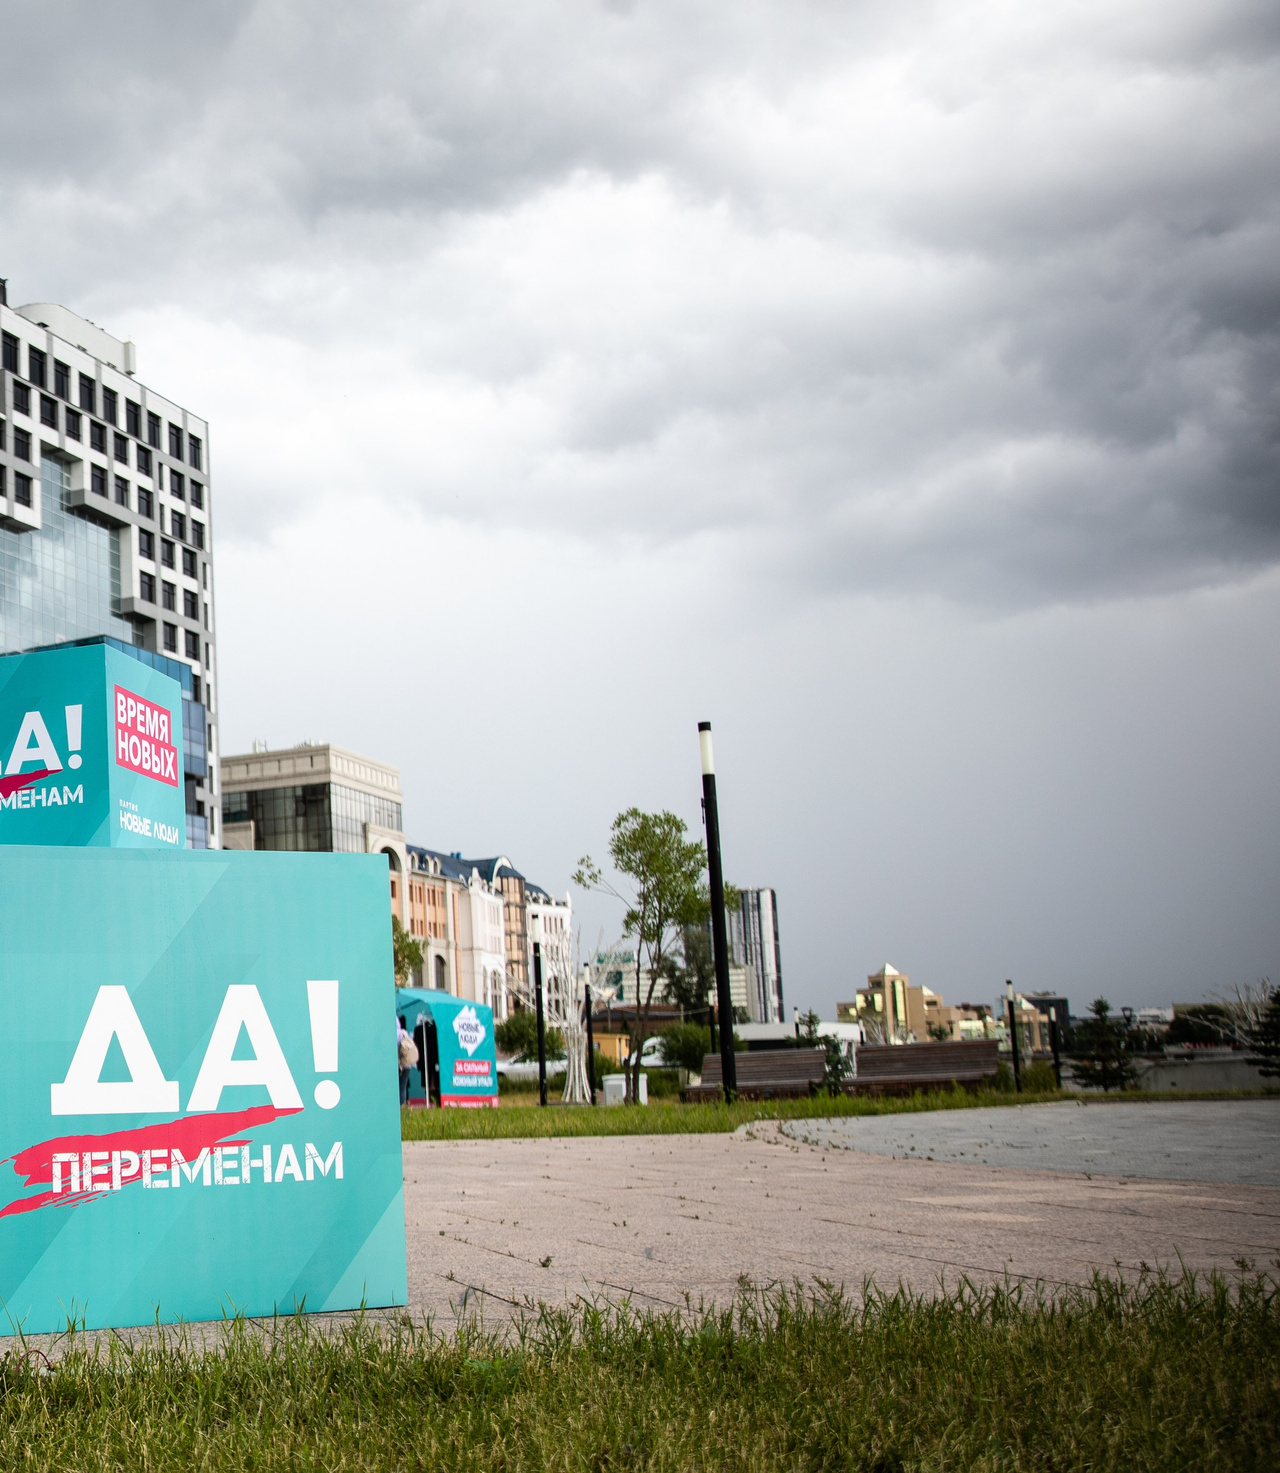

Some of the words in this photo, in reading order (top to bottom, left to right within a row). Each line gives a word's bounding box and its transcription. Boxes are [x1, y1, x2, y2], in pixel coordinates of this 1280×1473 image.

[117, 692, 169, 744] ВРЕМЯ
[117, 728, 176, 781] НОВЫХ
[119, 798, 139, 812] ПАРТИЯ
[120, 809, 152, 837] НОВЫЕ
[153, 821, 179, 846] ЛЮДИ
[50, 979, 341, 1116] ДА!
[51, 1141, 345, 1194] ПЕРЕМЕНАМ
